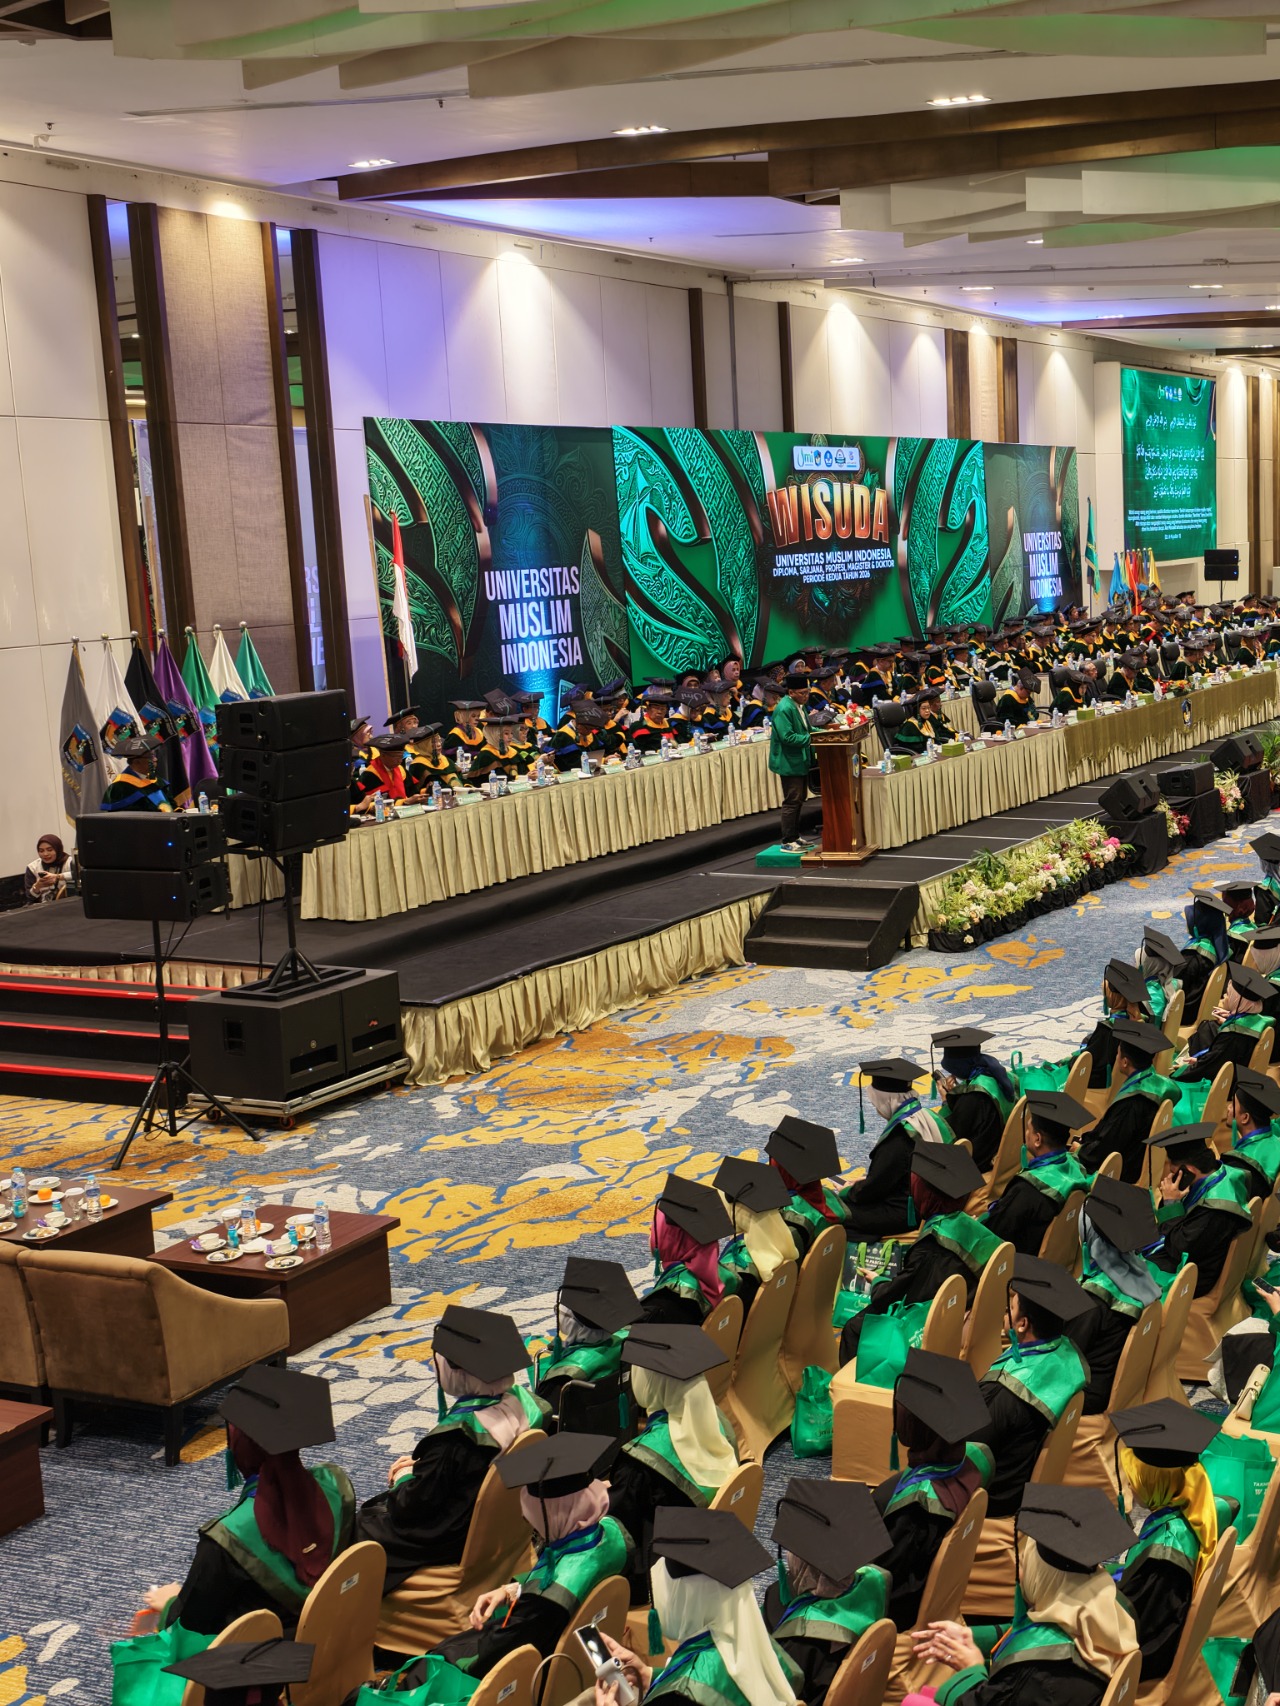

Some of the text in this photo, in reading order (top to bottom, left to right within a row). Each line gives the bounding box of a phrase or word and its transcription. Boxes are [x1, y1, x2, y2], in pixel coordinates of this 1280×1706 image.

[766, 481, 889, 548] WISUDA
[1023, 531, 1062, 552] UNIVERSITAS
[772, 567, 799, 577] DIPLOMA,
[799, 565, 825, 575] SARJANA,
[825, 563, 847, 573] PROFESI,
[847, 562, 871, 571] MAGISTER
[875, 559, 895, 568] DOKTOR
[775, 547, 892, 567] UNIVERSITAS MUSLIM INDONESIA
[1029, 552, 1059, 577] MUSLIM
[484, 565, 580, 601] UNIVERSITAS
[803, 573, 825, 584] PERIODE
[825, 572, 842, 582] KEDUA
[842, 571, 859, 580] TAHUN
[1030, 577, 1063, 599] INDONESIA
[498, 599, 573, 640] MUSLIM
[501, 636, 583, 675] INDONESIA
